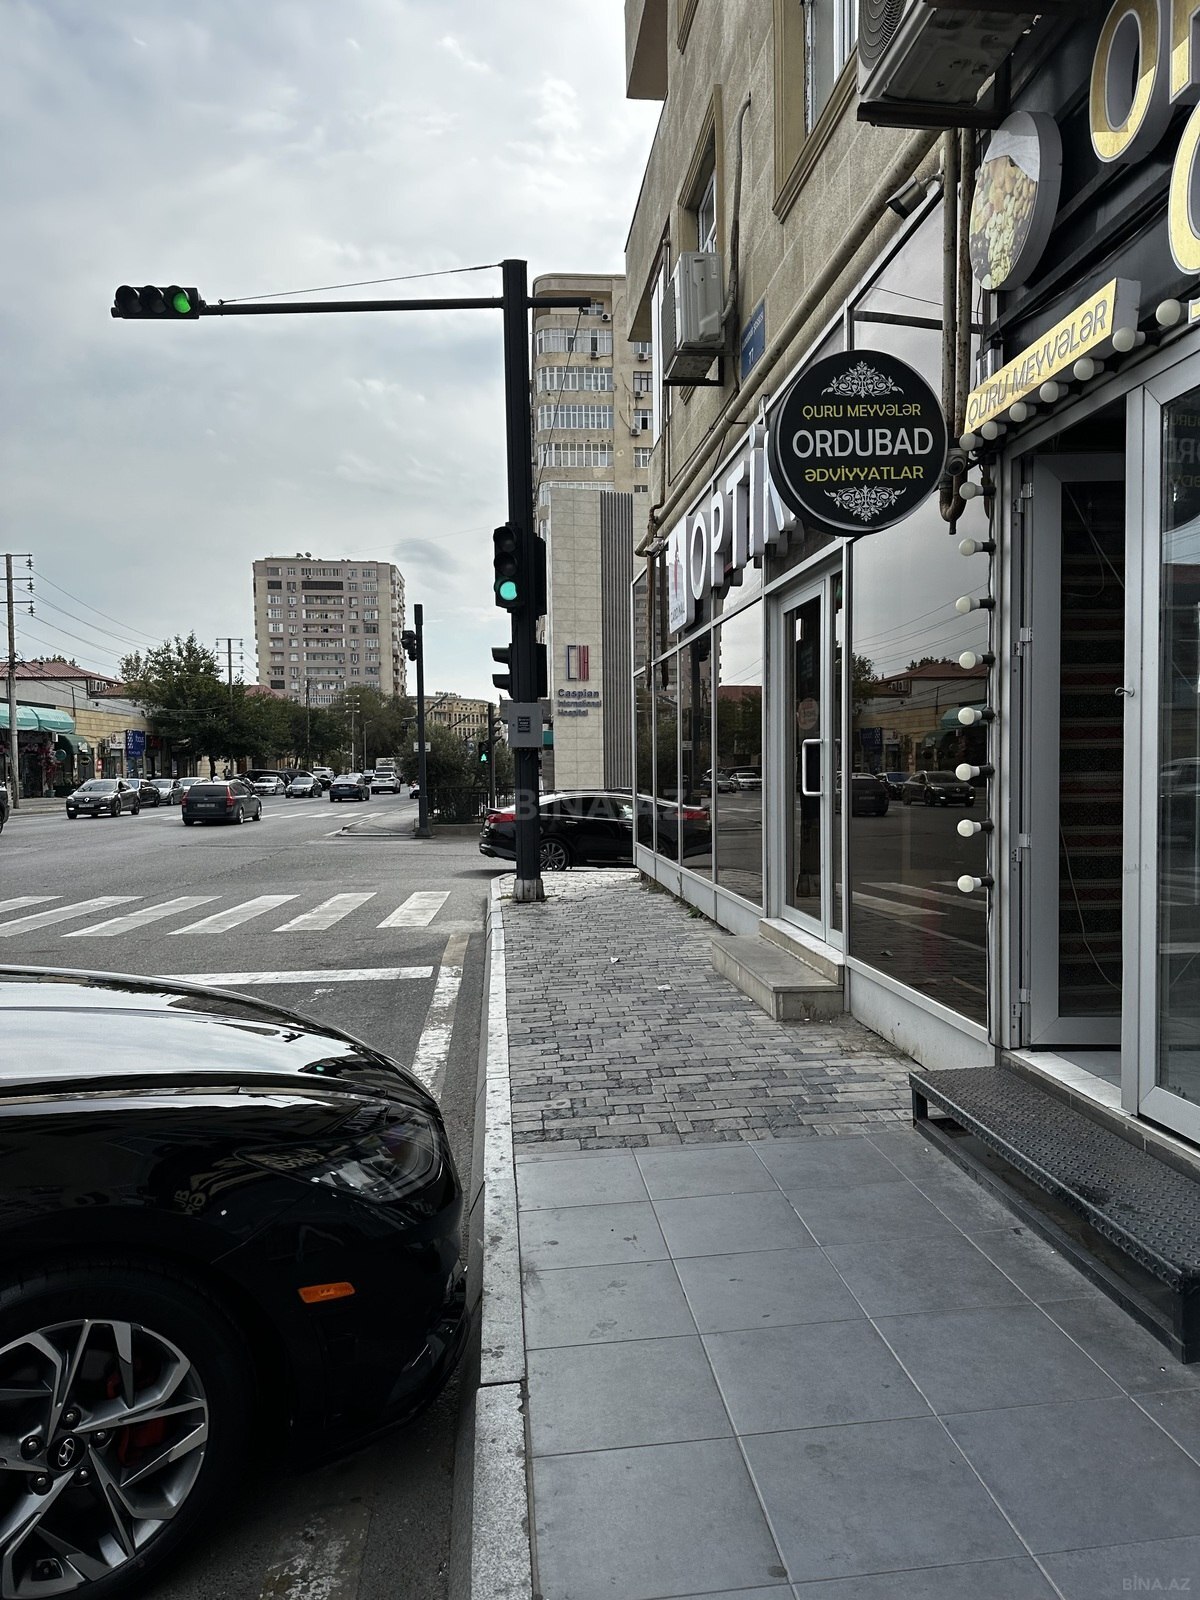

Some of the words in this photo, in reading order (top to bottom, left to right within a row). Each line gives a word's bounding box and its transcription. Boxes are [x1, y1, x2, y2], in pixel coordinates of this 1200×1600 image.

[967, 372, 1010, 427] QURU
[1011, 298, 1108, 396] MEYVƏLƏR
[802, 405, 843, 420] QURU
[847, 403, 921, 418] MEYVƏLƏR
[792, 427, 934, 459] ORDUBAD
[804, 465, 924, 482] ƏDVİYYATLAR
[558, 688, 600, 699] Caspian
